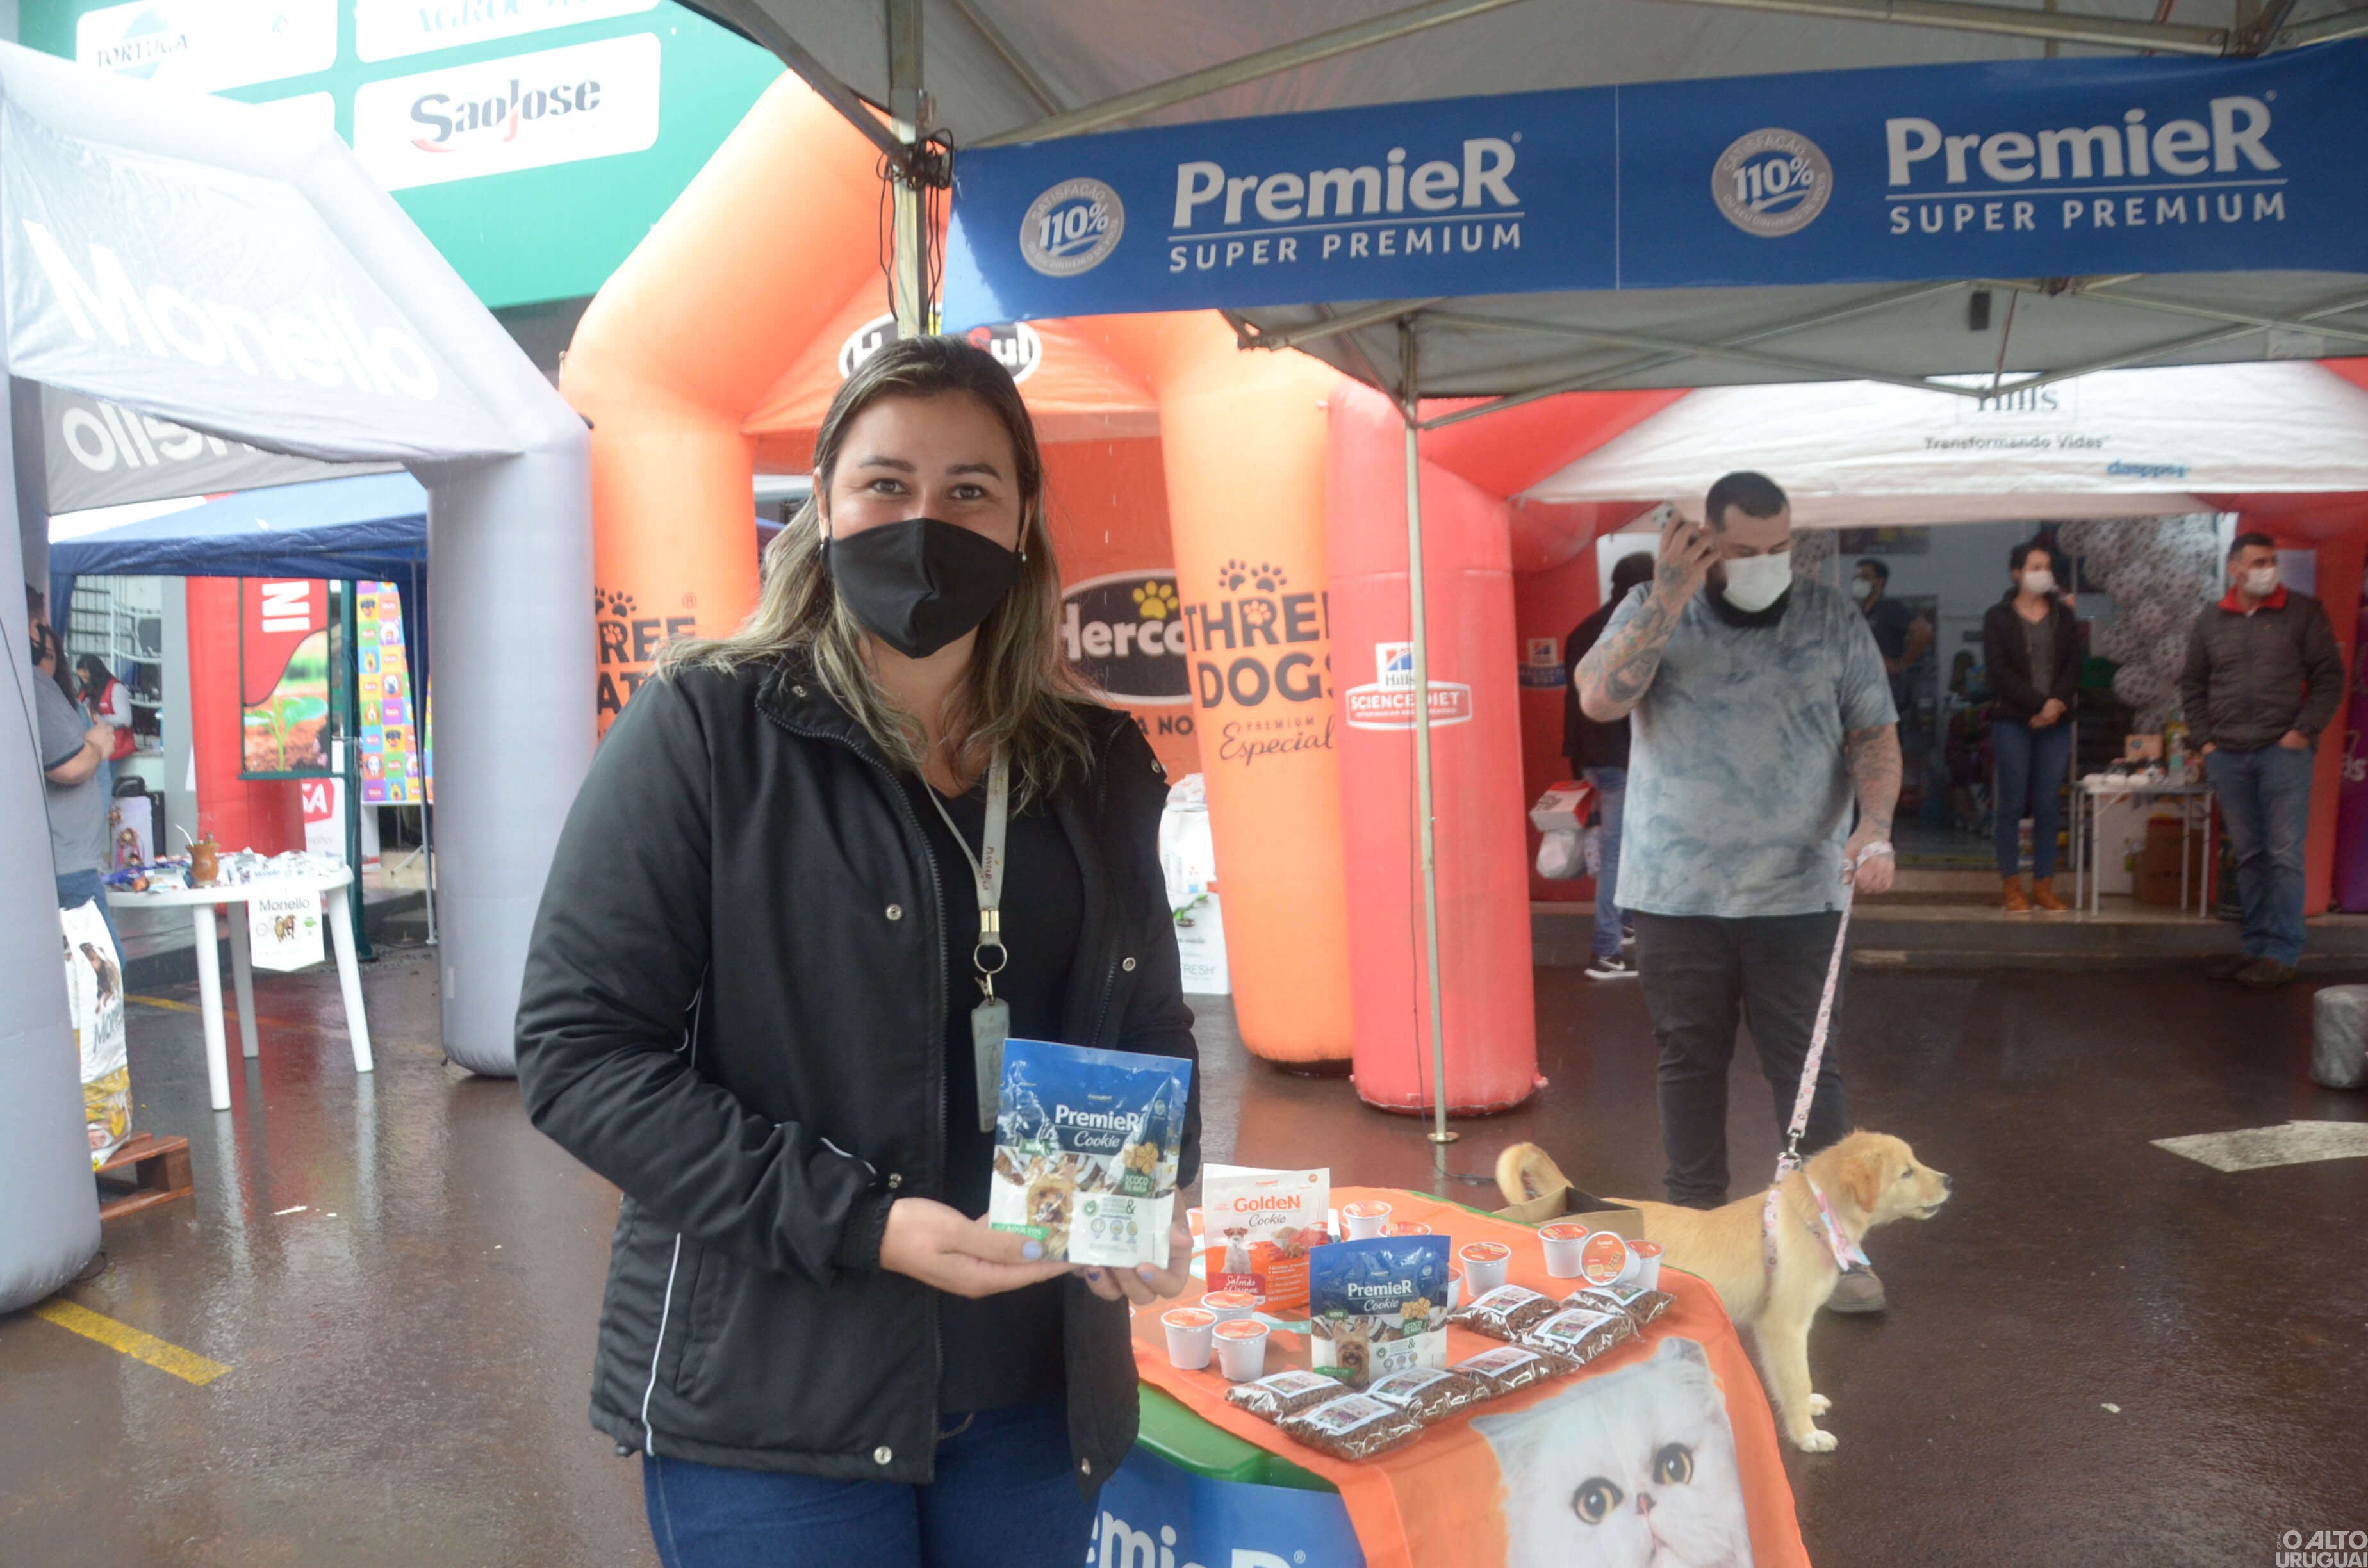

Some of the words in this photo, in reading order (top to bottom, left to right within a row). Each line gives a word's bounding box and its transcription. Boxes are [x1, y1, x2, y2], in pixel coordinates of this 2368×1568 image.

[1886, 95, 2282, 187] PremieR
[1172, 136, 1520, 230] PremieR
[1732, 156, 1814, 202] 110%
[1039, 202, 1109, 247] 110%
[1889, 203, 2036, 236] SUPER
[2063, 191, 2287, 229] PREMIUM
[1169, 236, 1297, 274] SUPER
[1322, 222, 1522, 260] PREMIUM
[22, 219, 439, 401] Monello
[1184, 591, 1330, 652] THRE
[1197, 651, 1334, 709] DOG
[1350, 693, 1415, 711] SCIENCE
[1219, 714, 1335, 767] Especial
[1247, 717, 1315, 731] PREMIUM
[259, 897, 311, 912] Monello
[1055, 1104, 1141, 1132] PremieR
[1073, 1131, 1121, 1148] Cookie
[1233, 1194, 1302, 1213] GoldeN
[1248, 1213, 1287, 1227] Cookie
[1347, 1279, 1413, 1298] PremieR
[1363, 1298, 1399, 1312] Cookie
